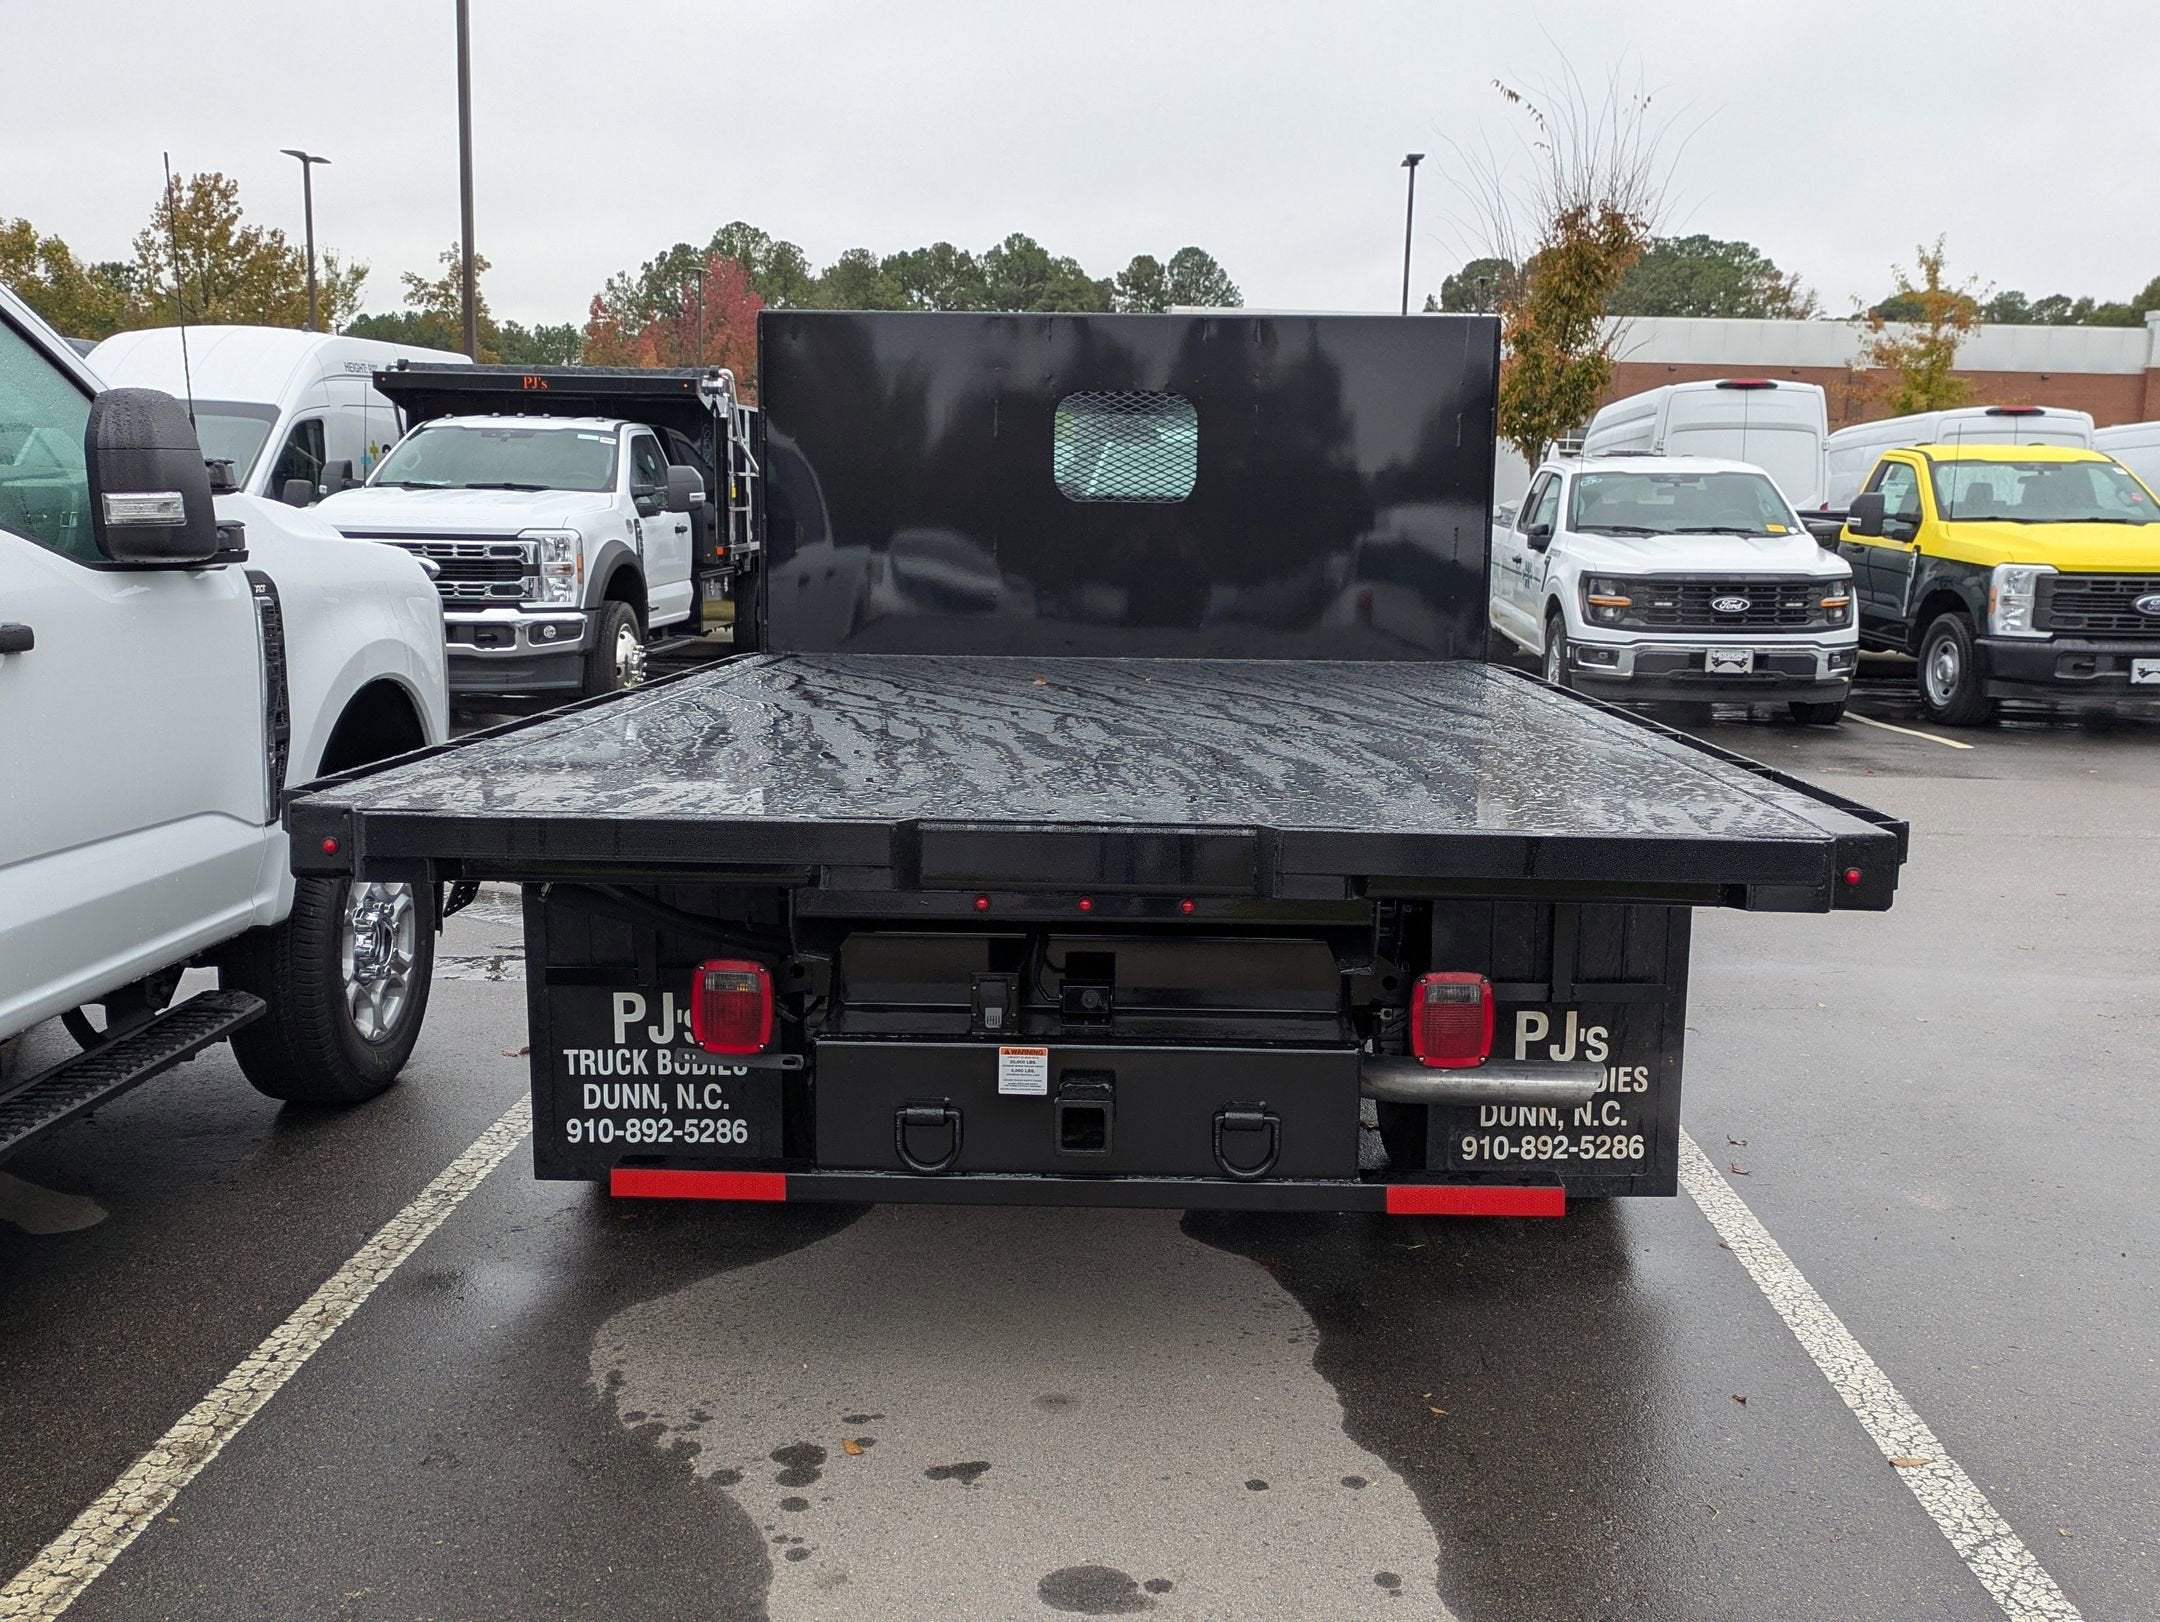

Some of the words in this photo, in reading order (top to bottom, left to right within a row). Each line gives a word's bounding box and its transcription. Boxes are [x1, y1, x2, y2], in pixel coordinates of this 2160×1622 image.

[523, 376, 549, 390] PJ's
[1719, 600, 1743, 610] Ford
[562, 1049, 649, 1076] TRUCK
[1595, 1066, 1649, 1093] IES
[583, 1083, 668, 1114] DUNN,
[676, 1083, 730, 1110] N.C.
[1480, 1105, 1564, 1132] DUNN,
[1573, 1100, 1628, 1127] N.C.
[565, 1118, 748, 1144] 910-892-5286
[1461, 1135, 1645, 1161] 910-892-5286
